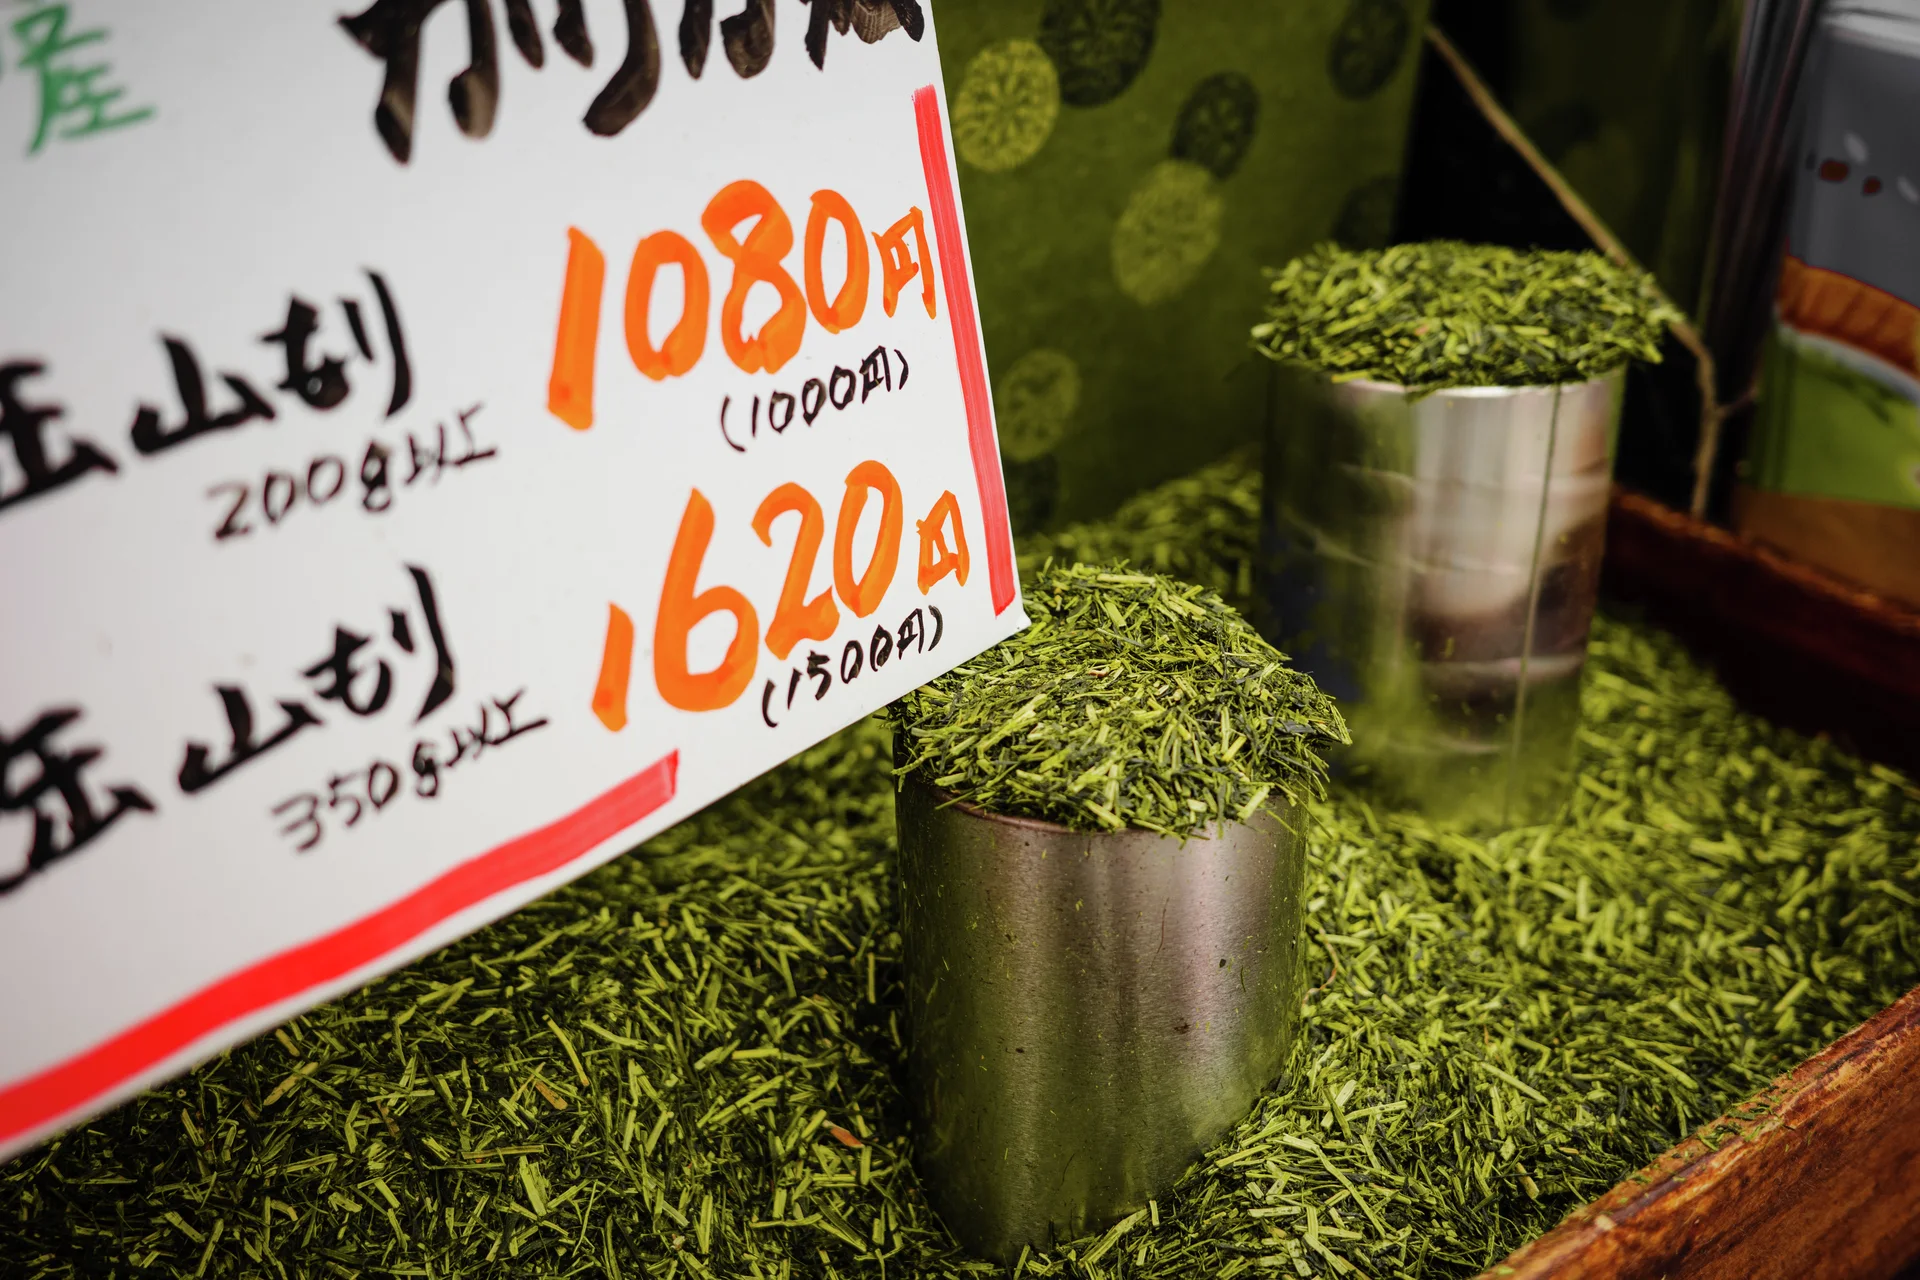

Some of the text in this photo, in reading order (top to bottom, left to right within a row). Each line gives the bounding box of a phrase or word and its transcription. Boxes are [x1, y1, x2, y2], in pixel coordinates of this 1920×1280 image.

[547, 179, 937, 431] 1080円
[719, 345, 910, 453] (1000円)
[591, 459, 971, 733] 1620円
